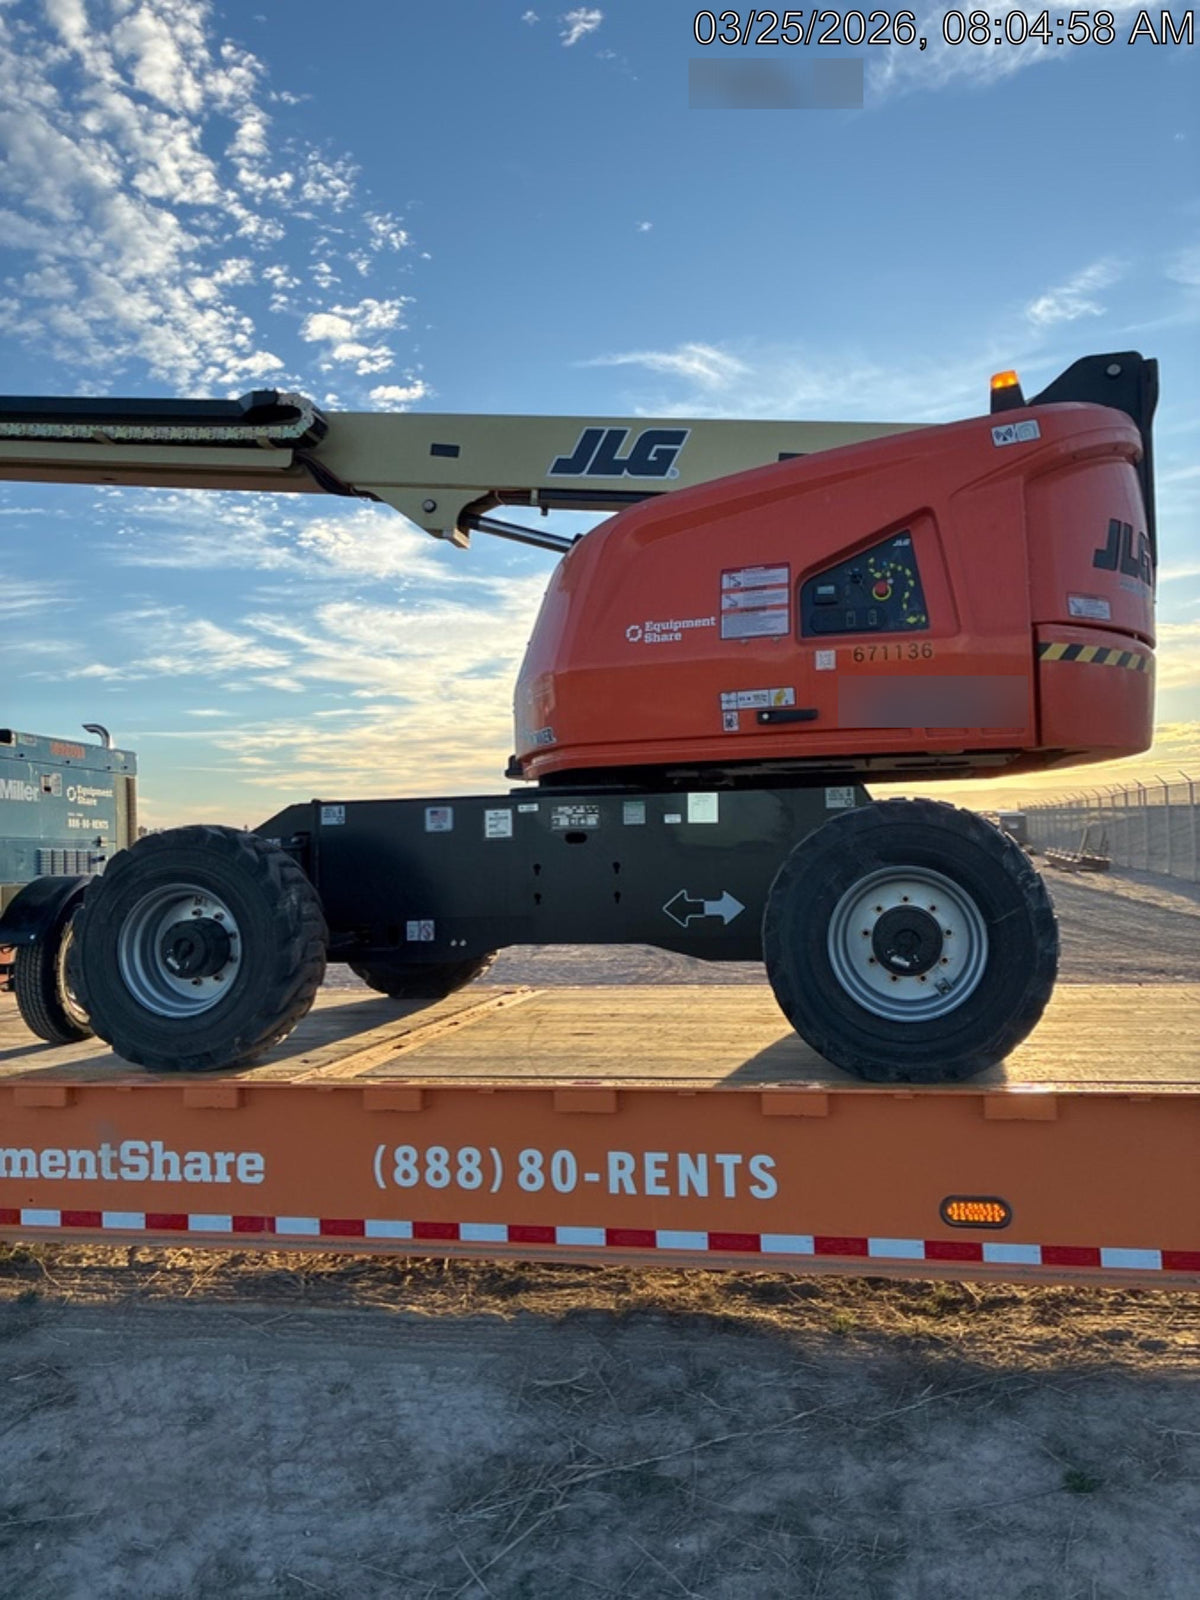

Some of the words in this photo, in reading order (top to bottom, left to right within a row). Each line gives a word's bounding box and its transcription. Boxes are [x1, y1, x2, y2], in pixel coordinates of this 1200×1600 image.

[548, 427, 691, 478] JLG
[1093, 518, 1152, 587] JLG
[644, 616, 716, 632] Equipment
[644, 632, 682, 644] Share
[853, 642, 933, 663] 671136
[0, 779, 40, 802] Miller
[0, 1140, 266, 1185] mentShare
[374, 1144, 503, 1194] (888)
[517, 1148, 779, 1200] 80-RENTS
